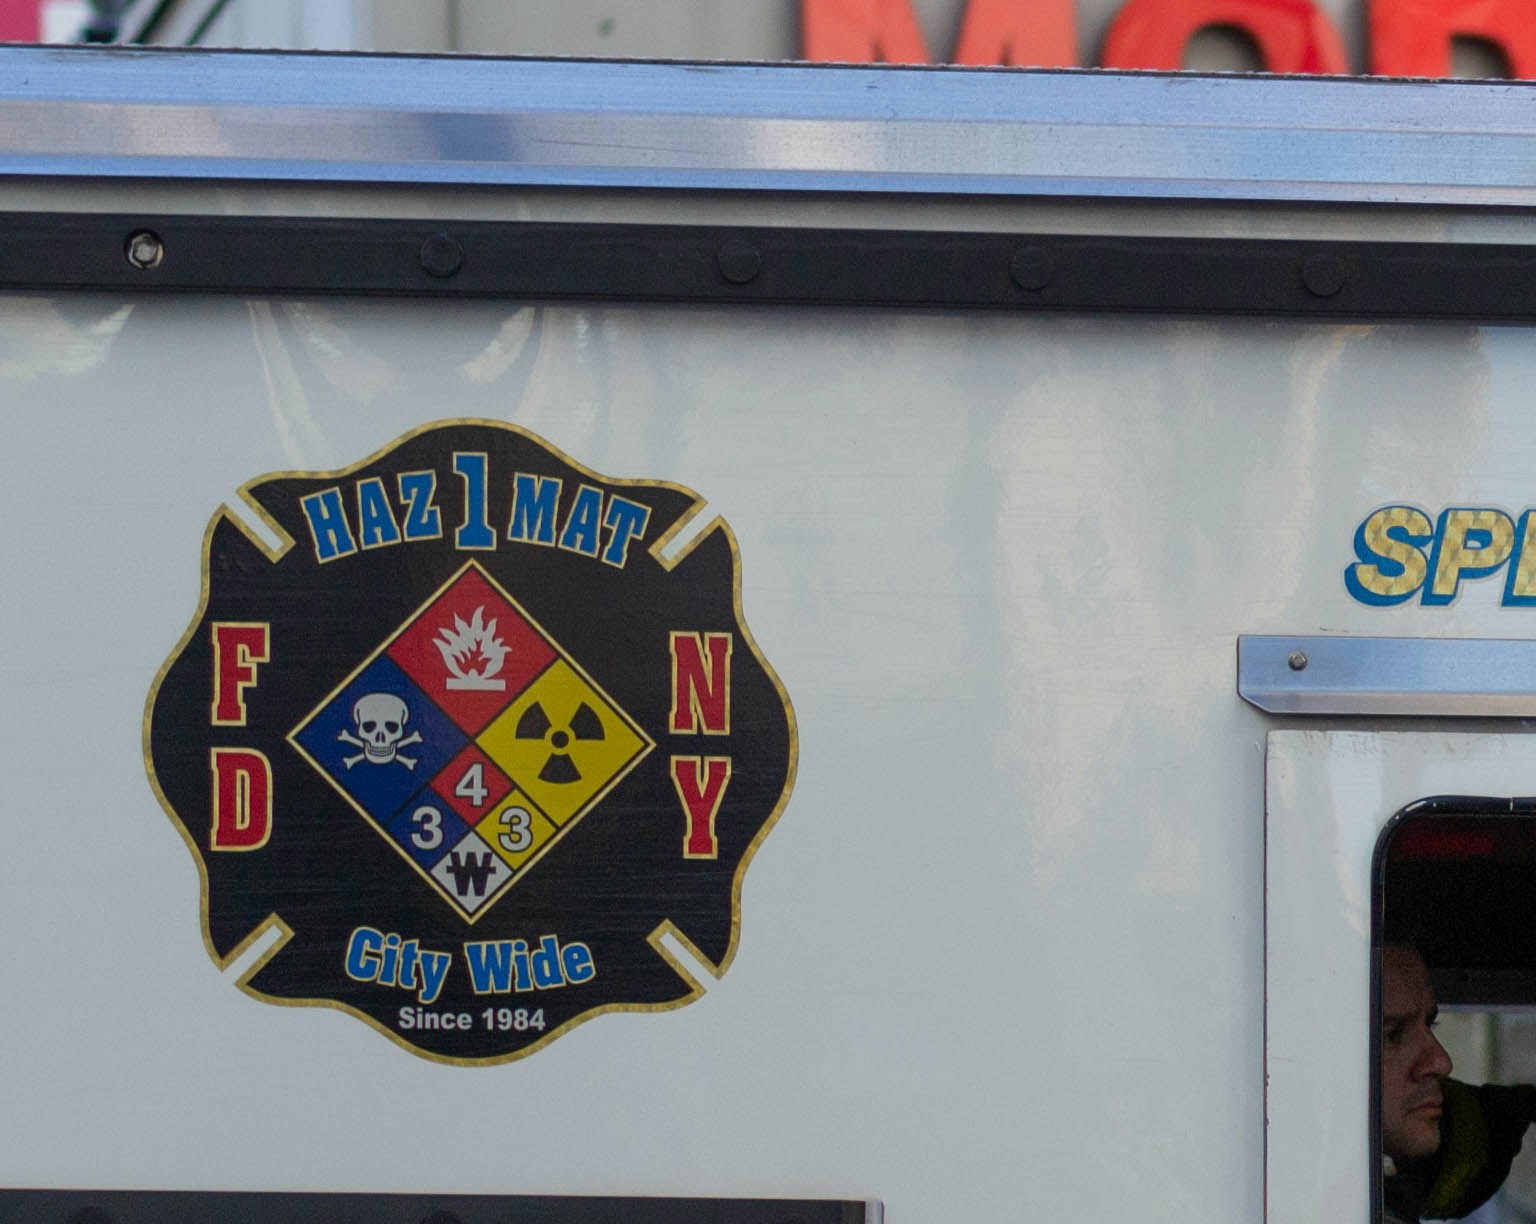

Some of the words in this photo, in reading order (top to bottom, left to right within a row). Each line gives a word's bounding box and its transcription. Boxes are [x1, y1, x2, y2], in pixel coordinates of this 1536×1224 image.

[299, 468, 442, 564] HAZ
[452, 451, 497, 550] 1
[507, 471, 652, 569] MAT
[454, 763, 488, 807] 4
[410, 805, 445, 850] 3
[498, 806, 533, 852] 3
[344, 925, 451, 1004] City
[464, 933, 597, 995] Wide
[398, 1006, 472, 1031] Since
[482, 1007, 546, 1032] 1984
